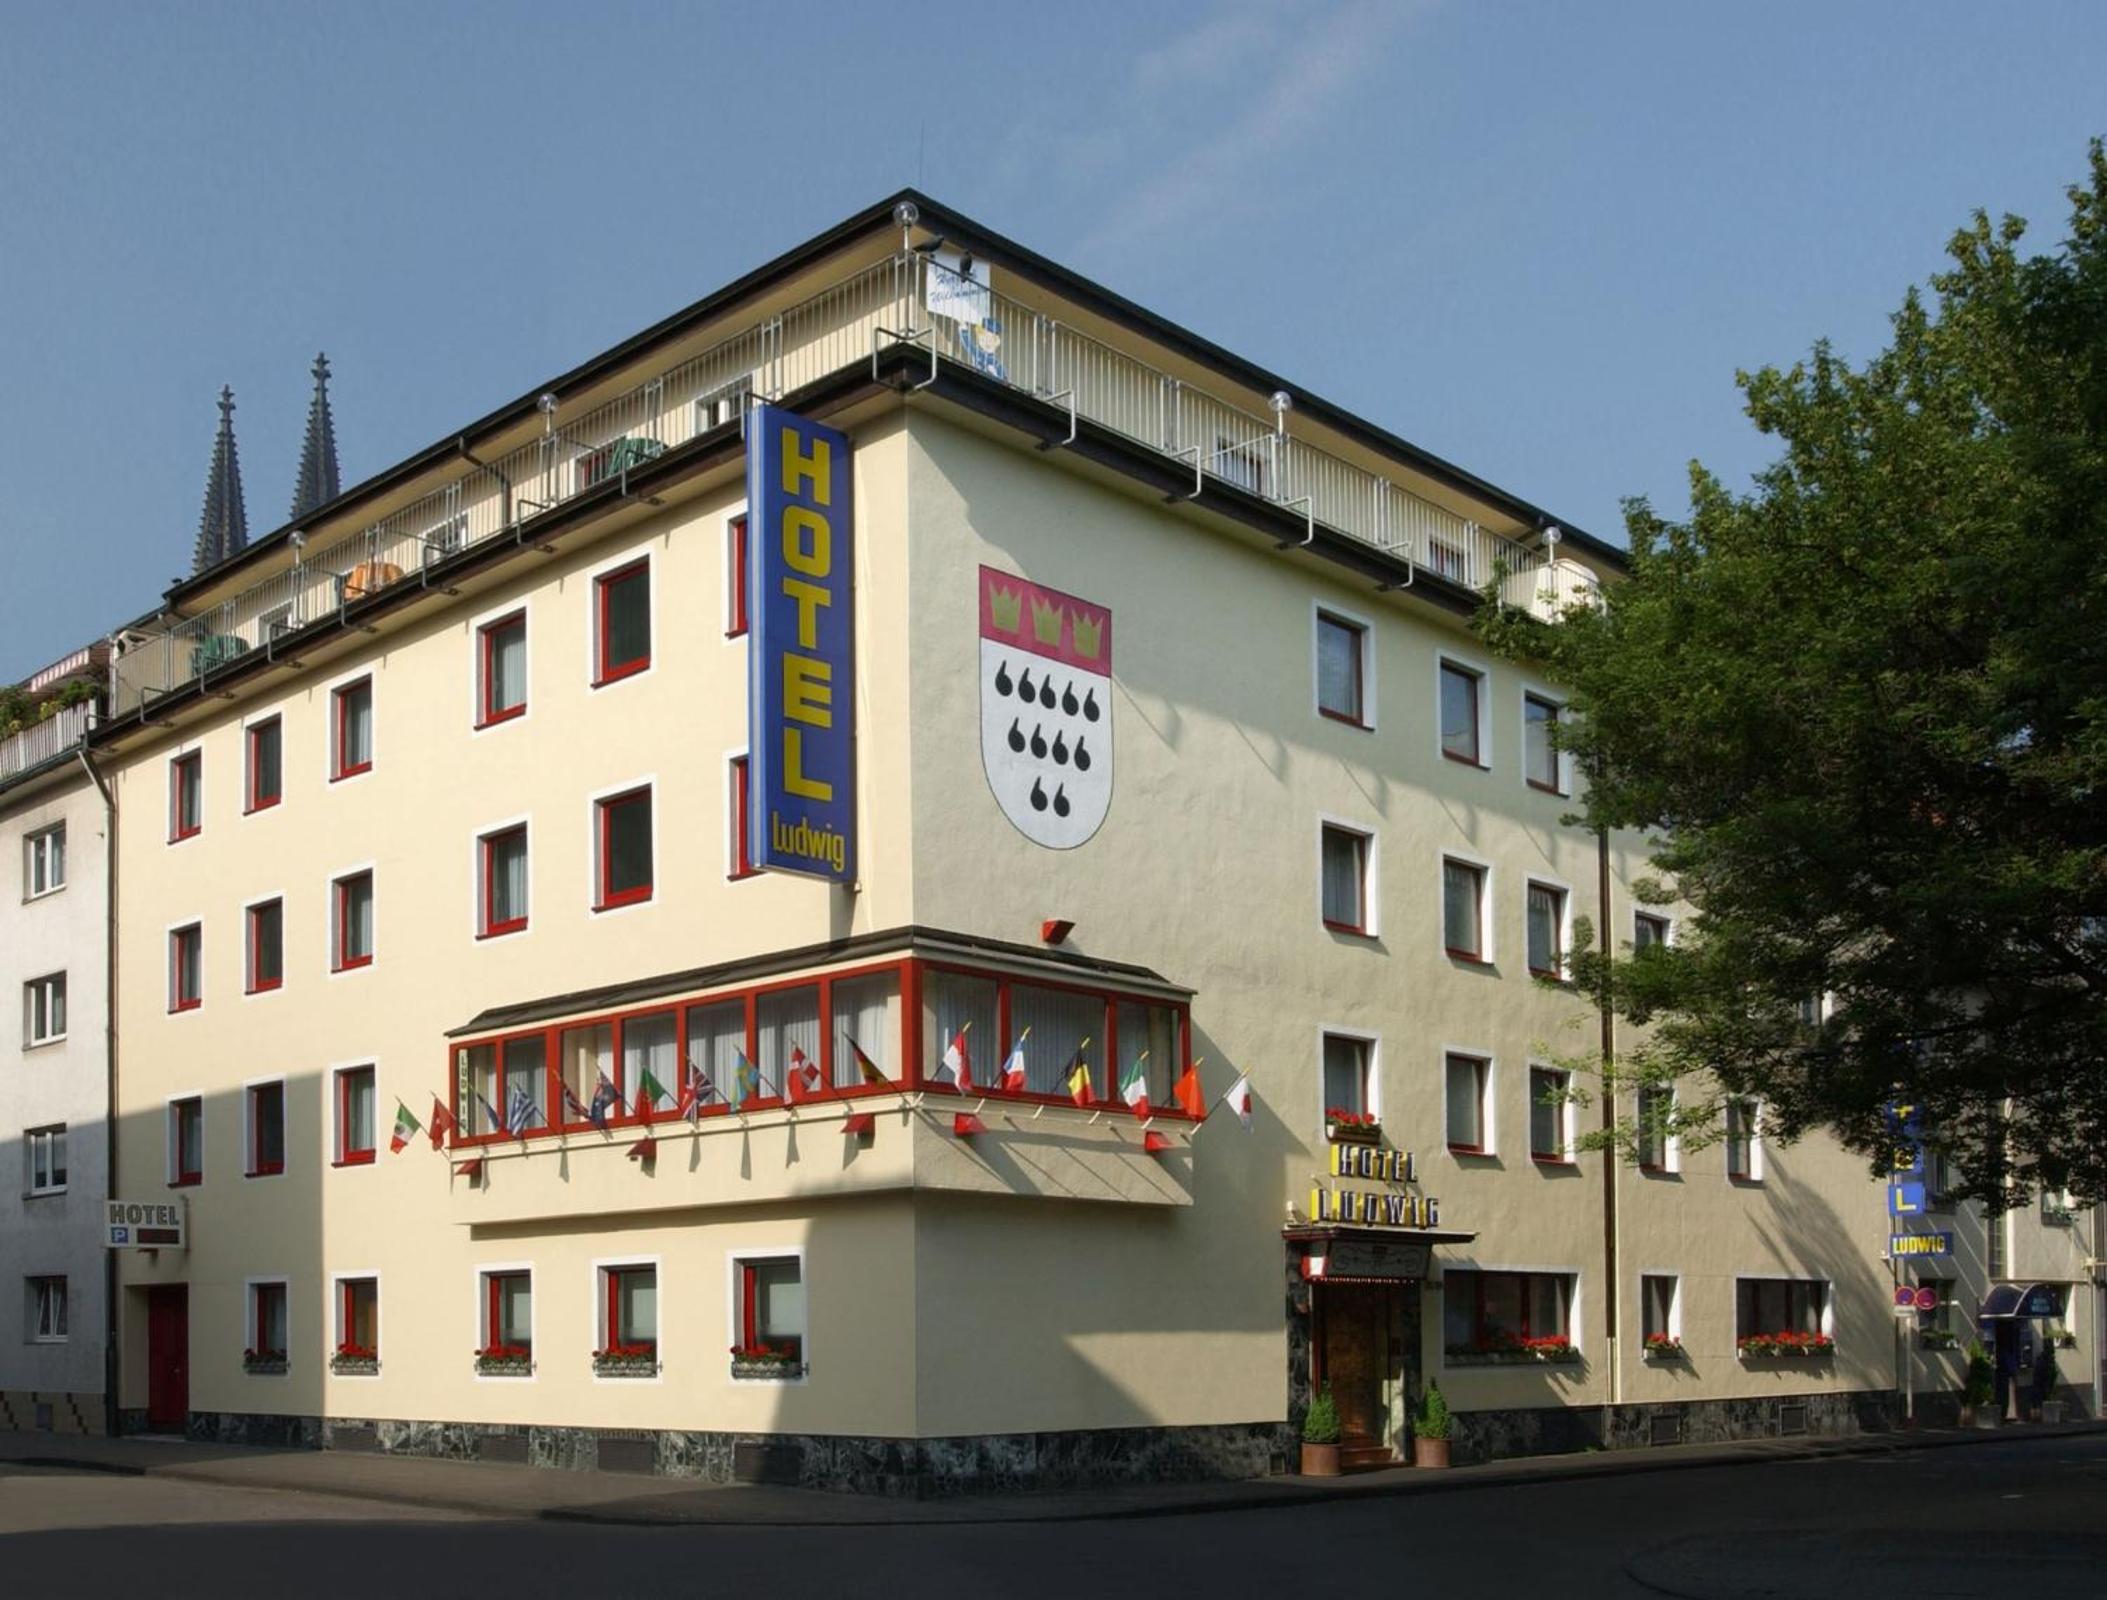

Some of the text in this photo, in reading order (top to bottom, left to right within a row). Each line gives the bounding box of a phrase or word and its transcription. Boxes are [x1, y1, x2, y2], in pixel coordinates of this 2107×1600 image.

[781, 428, 832, 801] HOTEL
[1330, 1144, 1417, 1181] HOTEL
[110, 1204, 179, 1225] HOTEL
[1312, 1189, 1439, 1226] LUDWIG
[115, 1230, 125, 1241] P
[1893, 1236, 1945, 1254] LUDWIG
